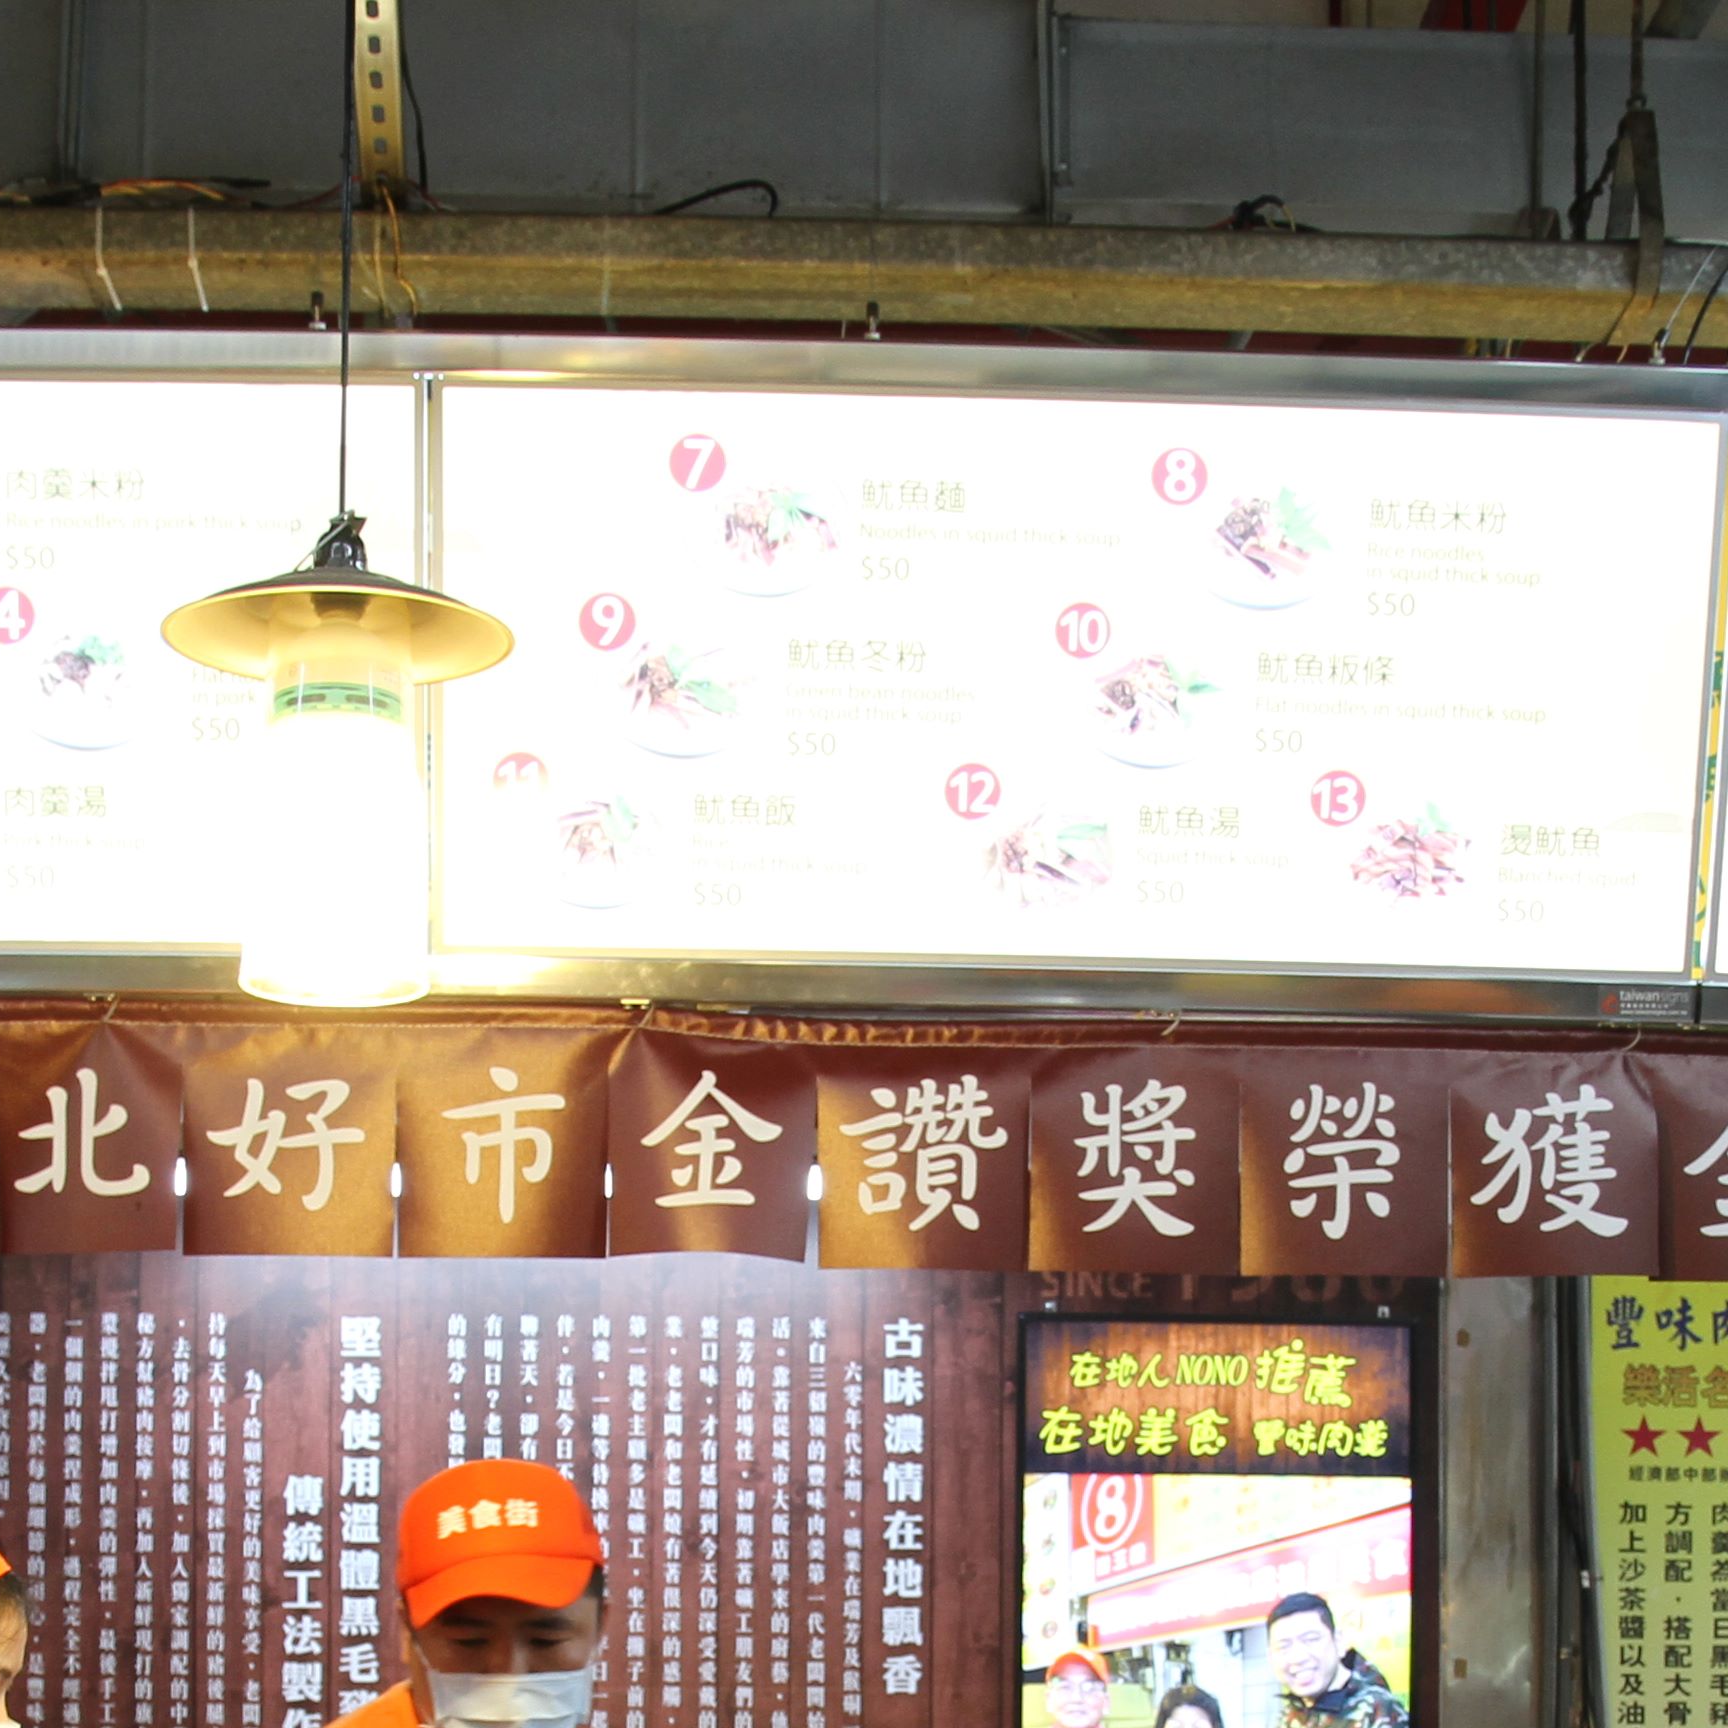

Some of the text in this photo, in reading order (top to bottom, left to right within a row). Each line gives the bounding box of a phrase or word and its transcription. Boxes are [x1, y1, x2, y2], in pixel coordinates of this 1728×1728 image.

[684, 440, 714, 489] 7
[1165, 450, 1196, 500] 8
[5, 467, 145, 500] 肉羹米粉
[862, 479, 967, 512] 魷魚麵
[859, 523, 938, 542] Noodles
[1369, 497, 1508, 534] 魷魚米粉
[5, 543, 55, 570] $50
[862, 555, 911, 583] $50
[1495, 571, 1541, 588] soup
[592, 596, 624, 646] 9
[1368, 591, 1417, 618] $50
[1059, 611, 1108, 652] 10
[787, 639, 928, 673] 魷魚冬粉
[1257, 651, 1394, 687] 魷魚粄條
[192, 715, 241, 742] $50
[787, 730, 838, 757] $50
[1254, 729, 1304, 756] $50
[5, 784, 107, 817] 肉羹湯
[951, 771, 996, 814] 12
[1315, 779, 1361, 818] 13
[693, 793, 798, 827] 魷魚飯
[1138, 804, 1241, 839] 魷魚湯
[1136, 880, 1185, 907] $50
[1497, 899, 1546, 925] $50
[1069, 1337, 1357, 1409] 在地人 NONO 推薦
[1038, 1404, 1390, 1458] 在地美食 豐味肉羹
[437, 1498, 539, 1540] 美食街
[882, 1317, 924, 1697] 古味濃情在地飄香
